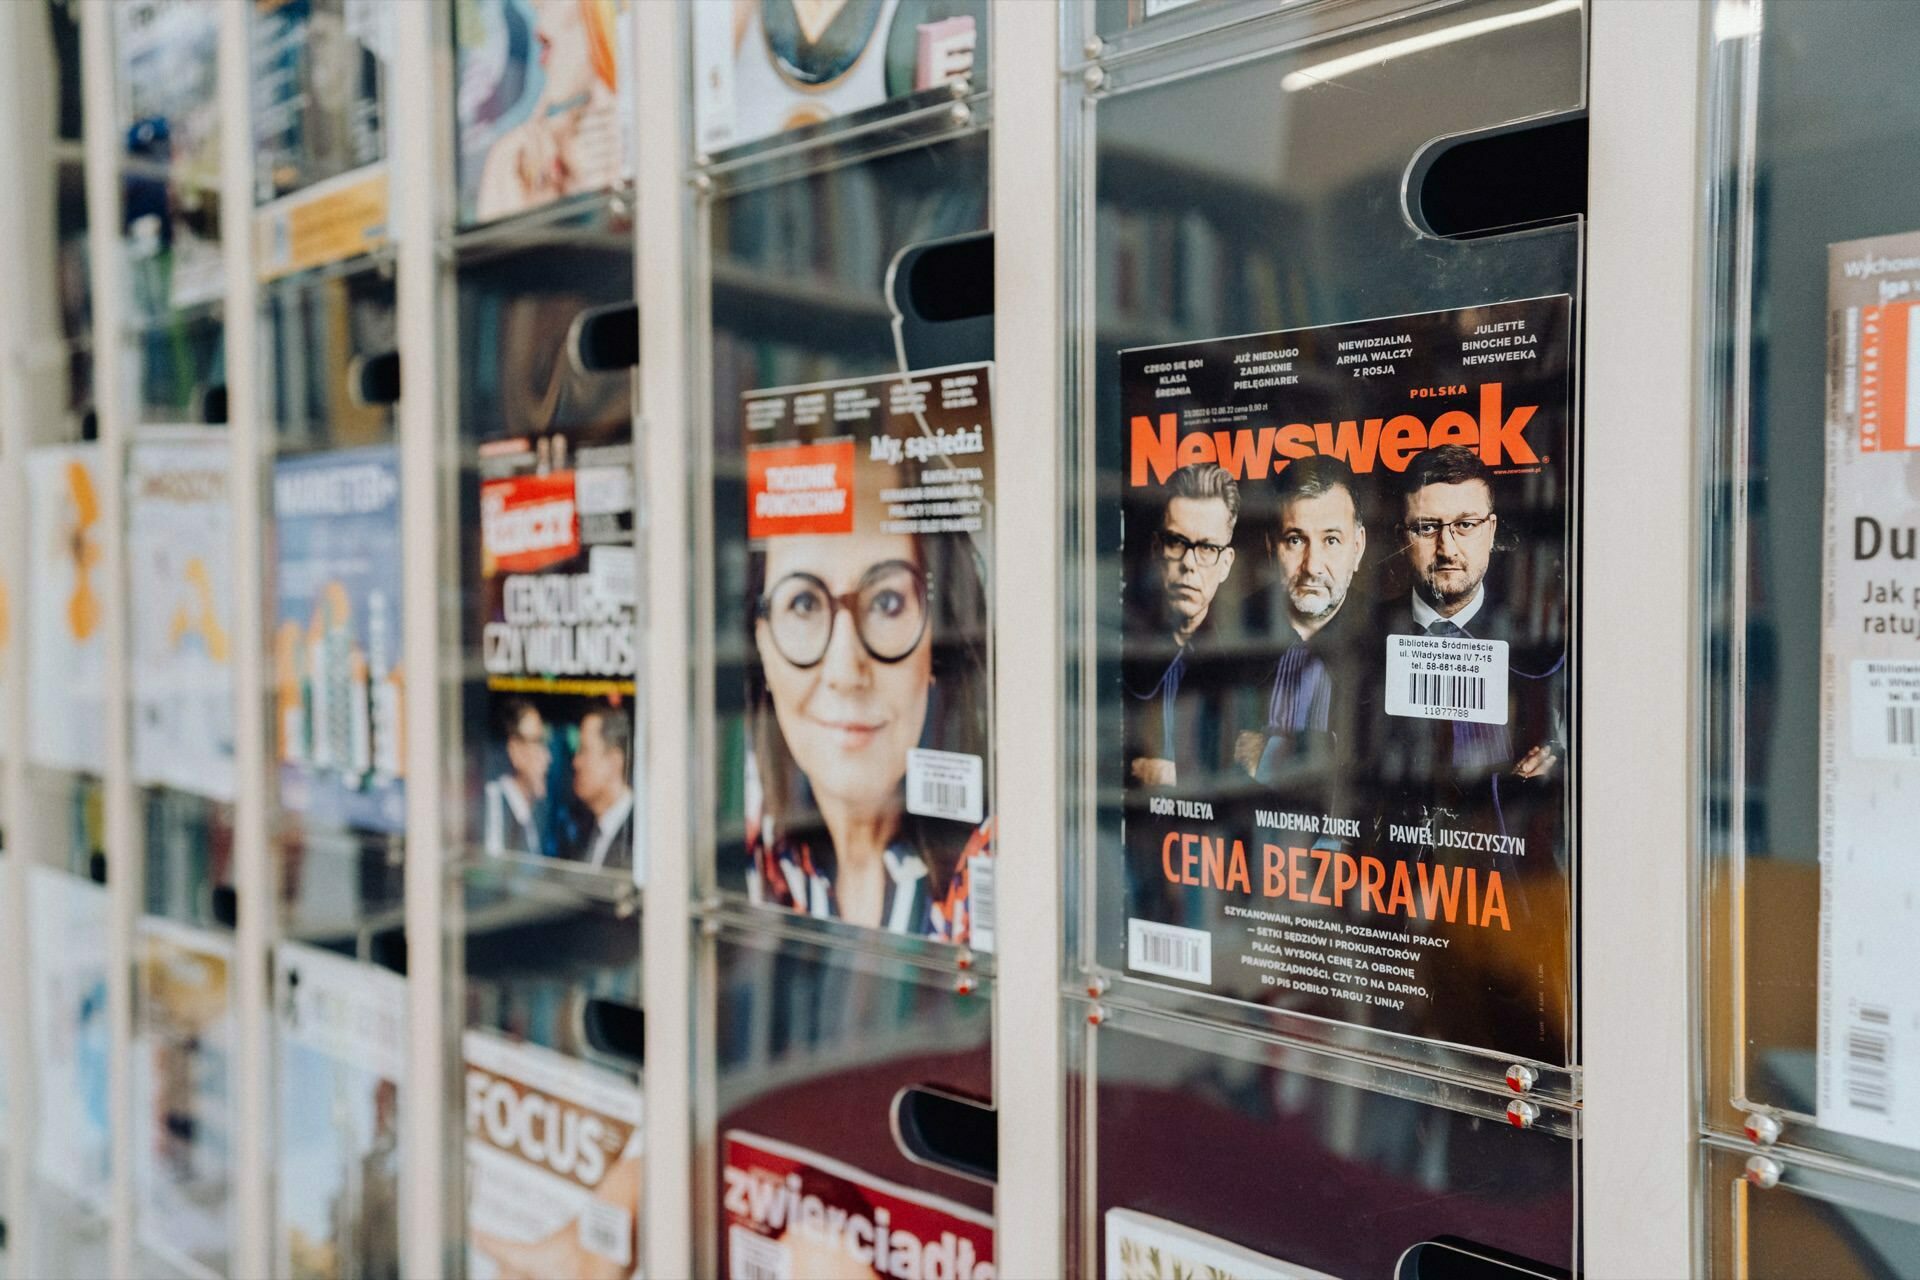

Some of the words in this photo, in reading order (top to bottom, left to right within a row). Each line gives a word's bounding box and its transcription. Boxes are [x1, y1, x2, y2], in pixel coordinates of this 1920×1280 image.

[1474, 320, 1525, 335] JULIETTE
[1338, 334, 1412, 351] NIEWIDZIALNA
[1462, 336, 1511, 351] BINOCHE
[1514, 334, 1538, 346] DLA
[1233, 351, 1251, 364] JUŻ
[1252, 348, 1300, 362] NIEDŁUGO
[1336, 352, 1369, 366] ARMIA
[1370, 348, 1414, 362] WALCZY
[1462, 349, 1537, 366] NEWSWEEKA
[1143, 362, 1173, 374] CZEGO
[1173, 360, 1187, 371] SIĘ
[1188, 359, 1204, 370] BOI
[1239, 362, 1293, 377] ZABRAKNIE
[1353, 368, 1361, 378] Z
[1362, 364, 1396, 377] ROSJĄ
[1159, 374, 1188, 385] KLASA
[1233, 375, 1299, 390] PIELĘGNIAREK
[1862, 311, 1880, 448] POLITYKA.PL
[1155, 386, 1192, 398] ŚREDNIA
[1410, 384, 1468, 399] POLSKA
[1130, 382, 1542, 487] Newsweek
[1854, 515, 1916, 561] Du
[1862, 579, 1904, 604] Jak
[1399, 638, 1439, 649] Biblioteka
[1441, 639, 1494, 652] Śródmieście
[1399, 650, 1409, 658] ul.
[1411, 650, 1461, 661] Władysława
[1474, 654, 1492, 663] 7-15
[1411, 662, 1424, 670] tel.
[1150, 797, 1175, 816] IGOR
[1176, 799, 1214, 821] TULEYA
[1255, 809, 1320, 833] WALDEMAR
[1321, 814, 1361, 838] ŻUREK
[1389, 824, 1434, 846] PAWEŁ
[1437, 829, 1526, 856] JUSZCZYSZYN
[1161, 831, 1252, 895] CENA
[1263, 844, 1512, 932] BEZPRAWIA
[1224, 906, 1293, 926] SZYKANOWANI,
[1295, 916, 1344, 934] PONIŻANI,
[1345, 925, 1410, 944] POZBAWIANI
[1413, 935, 1450, 949] PRACY
[1256, 927, 1282, 940] SETKI
[1284, 931, 1328, 947] SĘDZIÓW
[1329, 938, 1334, 948] I
[1335, 939, 1421, 962] PROKURATORÓW
[1252, 941, 1283, 956] PŁACĄ
[1284, 946, 1325, 964] WYSOKĄ
[1327, 955, 1353, 968] CENĘ
[1355, 959, 1369, 971] ZA
[1371, 962, 1416, 980] OBRONĘ
[1241, 955, 1331, 980] PRAWORZĄDNOŚCI.
[1332, 971, 1352, 984] CZY
[1354, 975, 1369, 987] TO
[1370, 979, 1386, 990] NA
[1387, 981, 1429, 999] DARMO,
[1261, 974, 1275, 986] BO
[1292, 980, 1329, 996] DOBIŁO
[1330, 987, 1363, 1003] TARGU
[1365, 995, 1373, 1005] Z
[1374, 996, 1405, 1012] UNIĄ?
[466, 1070, 605, 1186] FOCUS
